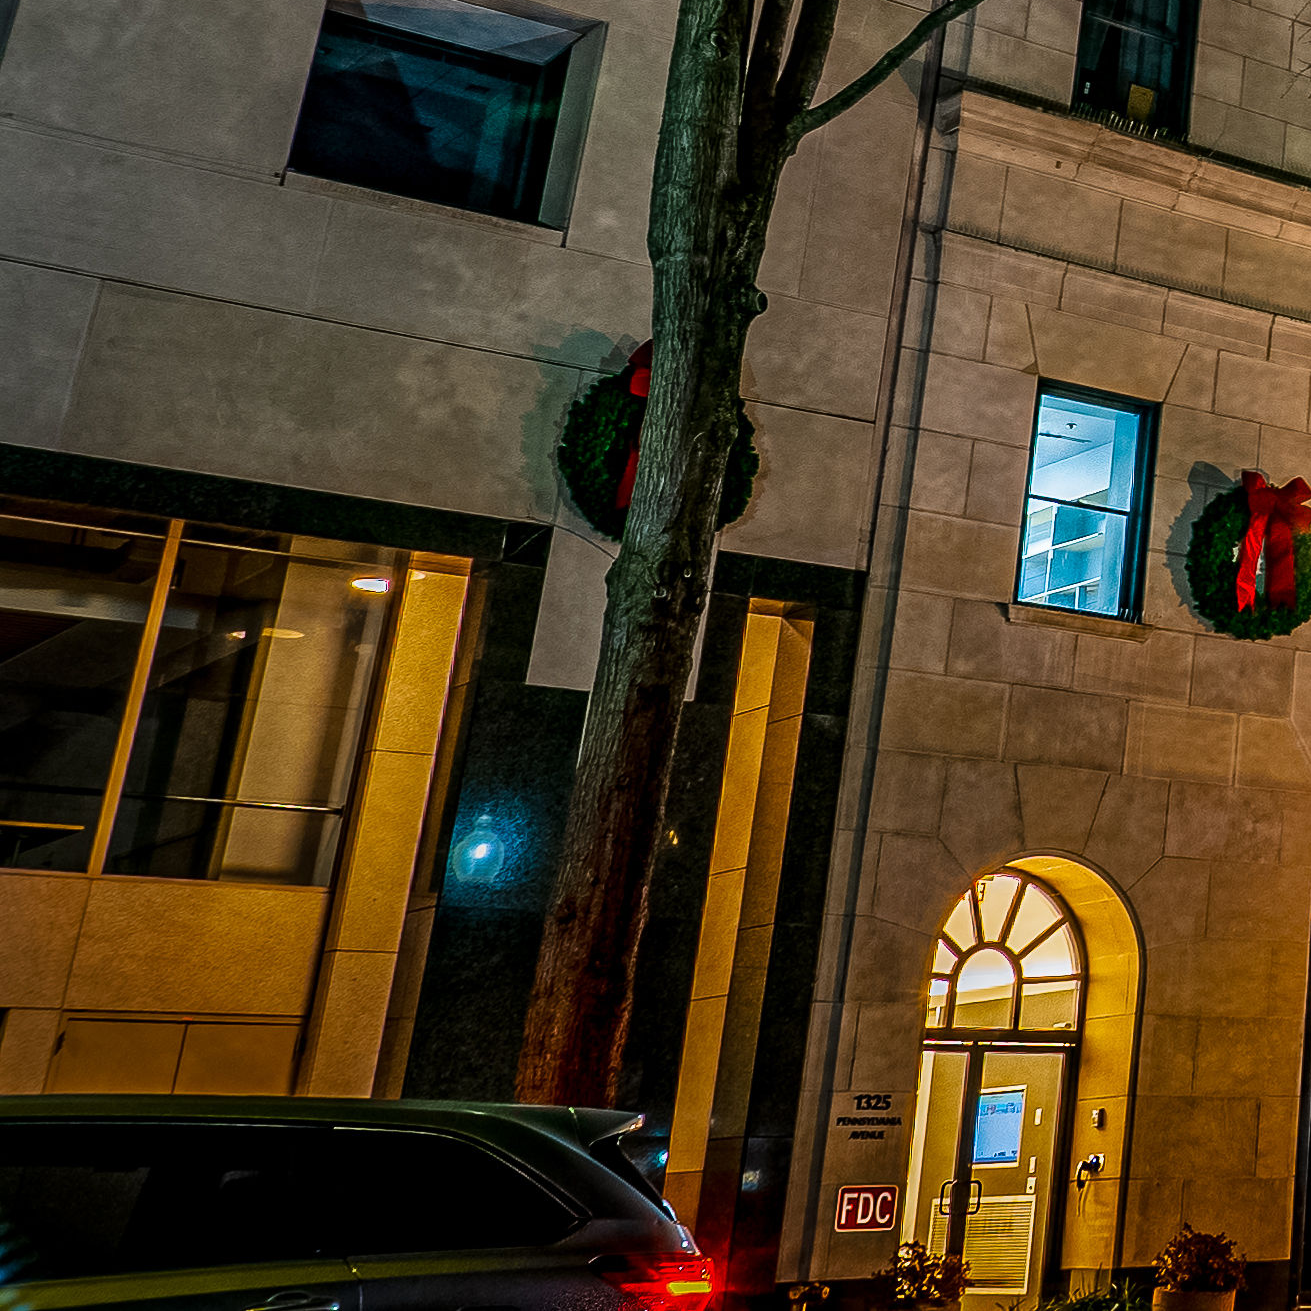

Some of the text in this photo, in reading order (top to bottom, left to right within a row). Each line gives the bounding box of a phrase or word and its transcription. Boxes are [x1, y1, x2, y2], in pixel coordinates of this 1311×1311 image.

[853, 1094, 892, 1110] 1325
[836, 1117, 902, 1126] PENNSYLVANIA
[848, 1131, 886, 1140] AVENUE
[840, 1192, 892, 1225] FDC
